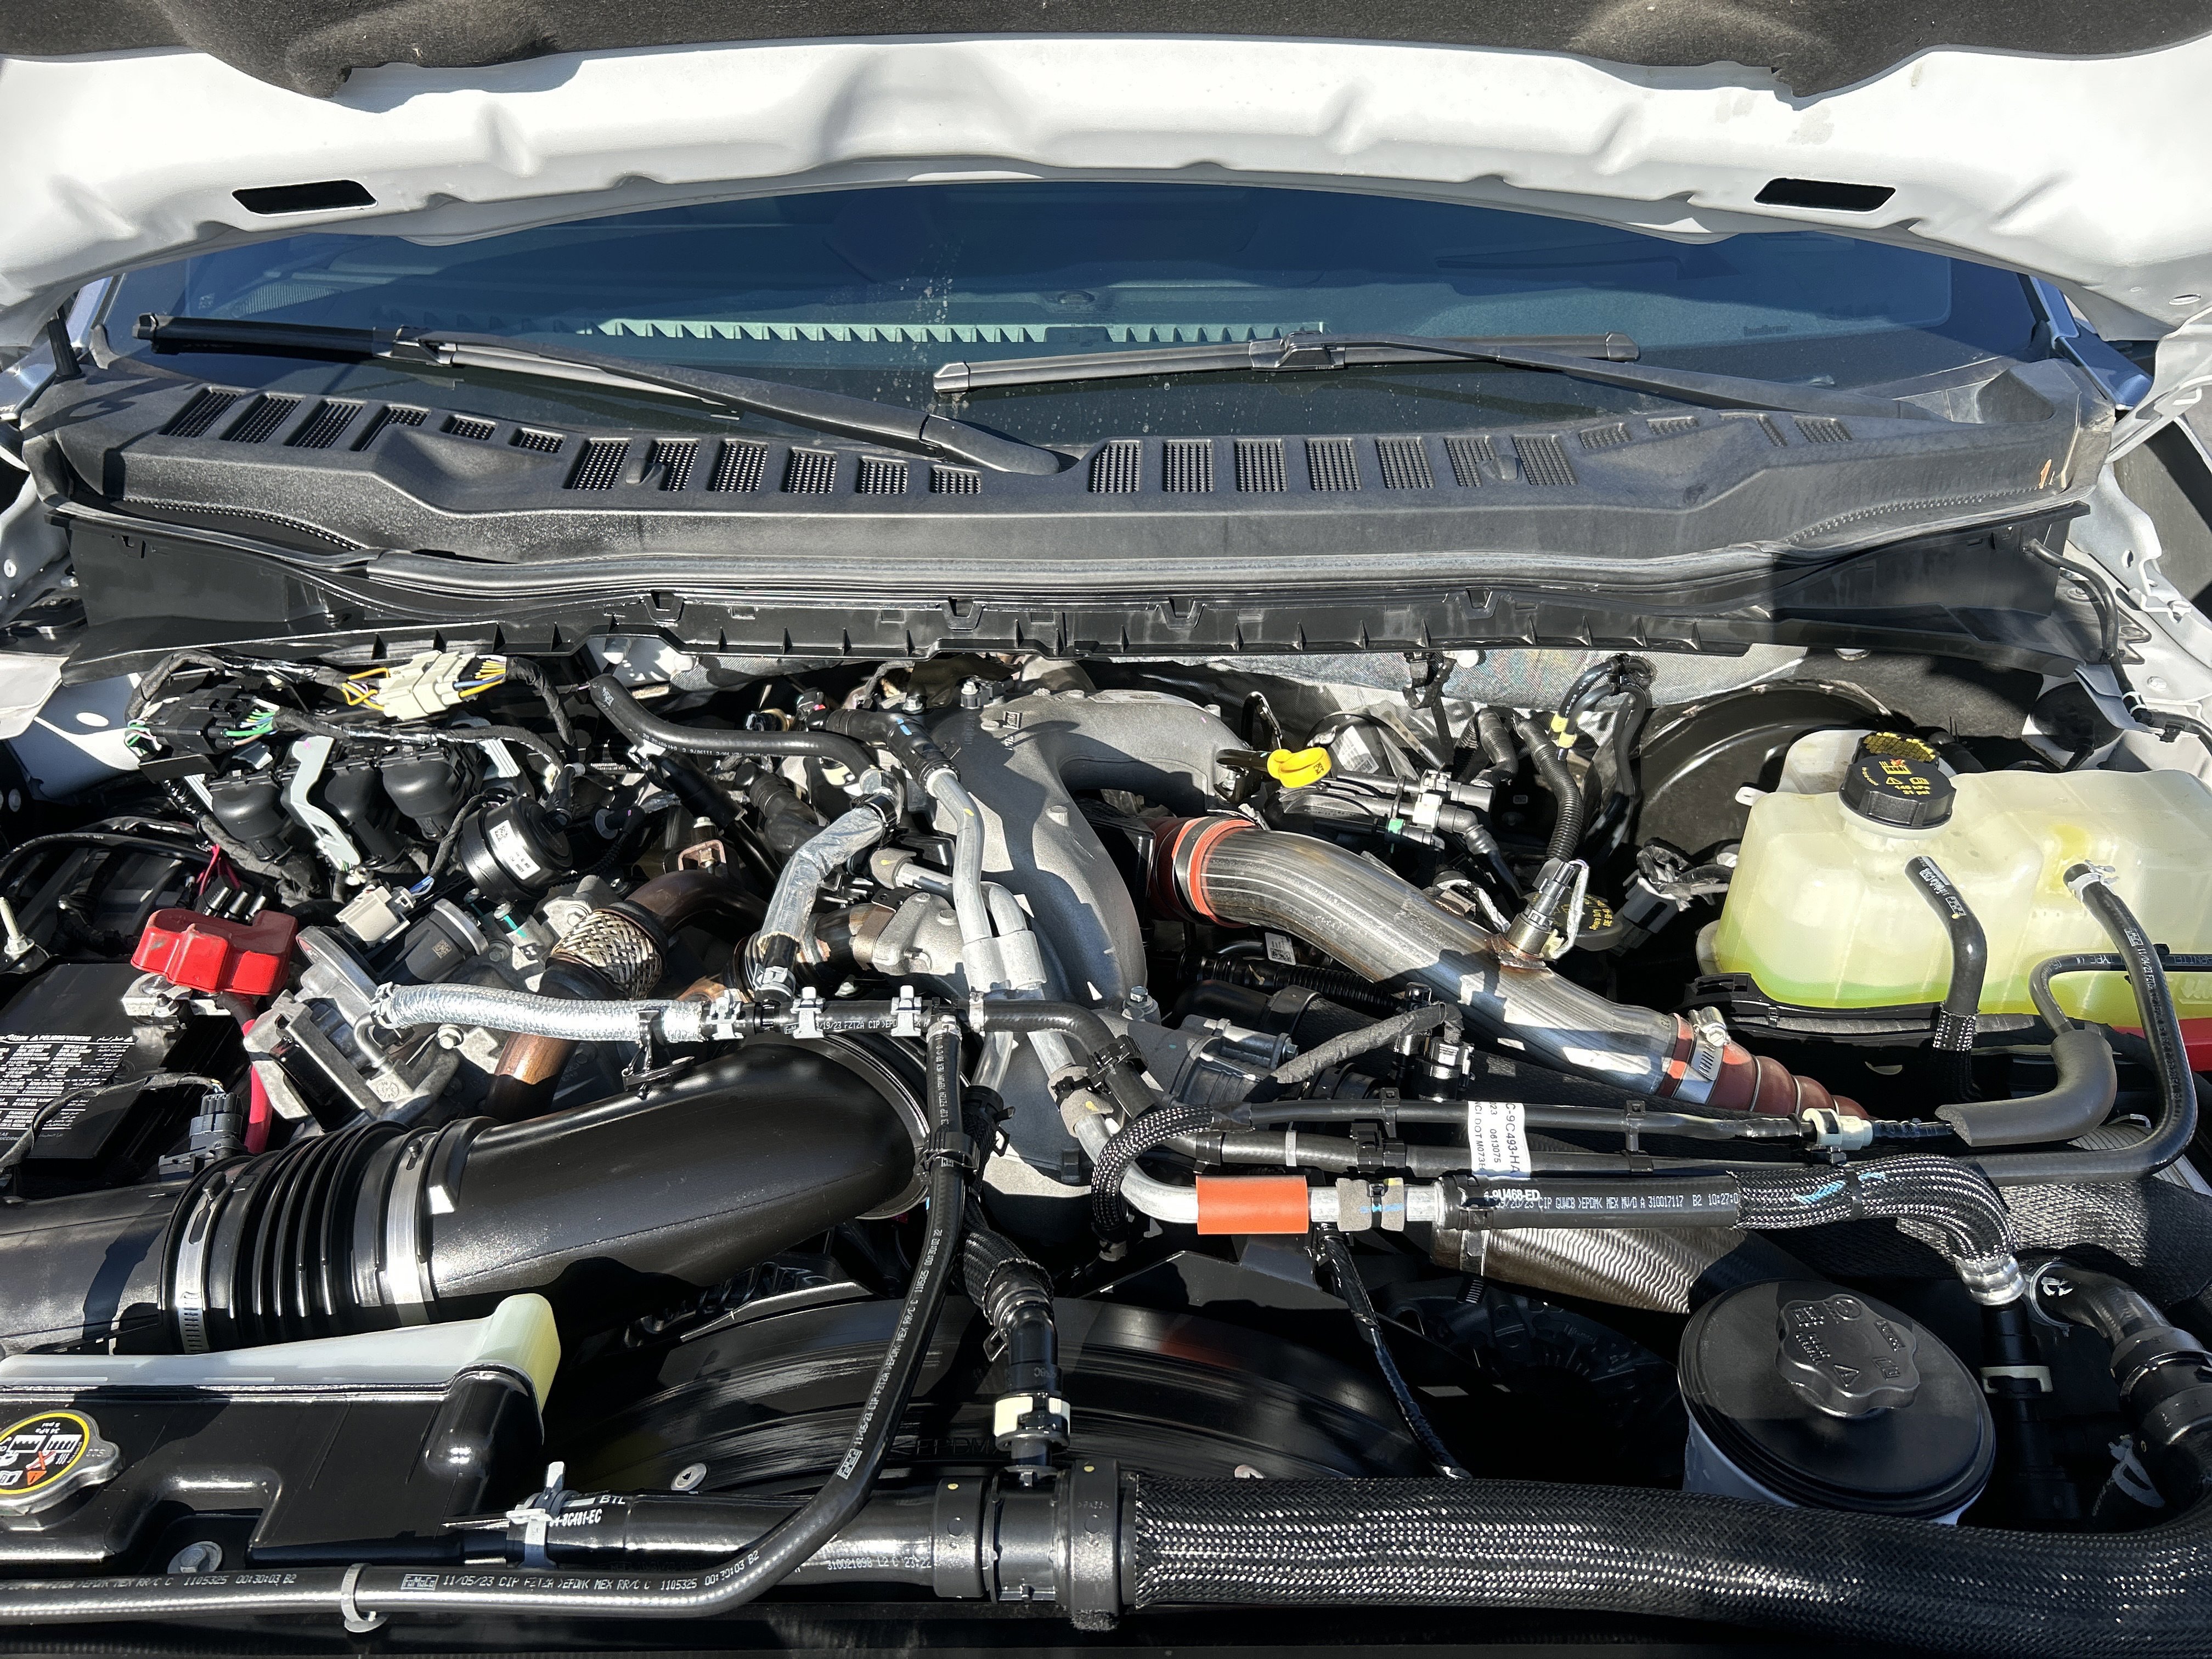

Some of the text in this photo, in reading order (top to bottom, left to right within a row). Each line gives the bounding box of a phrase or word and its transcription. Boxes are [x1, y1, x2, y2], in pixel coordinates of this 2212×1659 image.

[868, 1020, 881, 1029] CIP
[1490, 1128, 1501, 1163] 0613075
[1538, 1197, 1553, 1210] CIP
[1640, 1196, 1645, 1209] A
[1692, 1194, 1702, 1207] B2
[599, 1494, 626, 1505] BTL
[443, 1575, 495, 1587] 11/05/23
[594, 1578, 613, 1590] MEX
[617, 1578, 640, 1590] RR/C
[660, 1578, 697, 1590] 1105325
[748, 1550, 759, 1565] B2
[165, 1577, 174, 1587] C
[183, 1575, 229, 1587] 1105325
[235, 1574, 281, 1585] 00:30:03
[282, 1573, 297, 1585] B2
